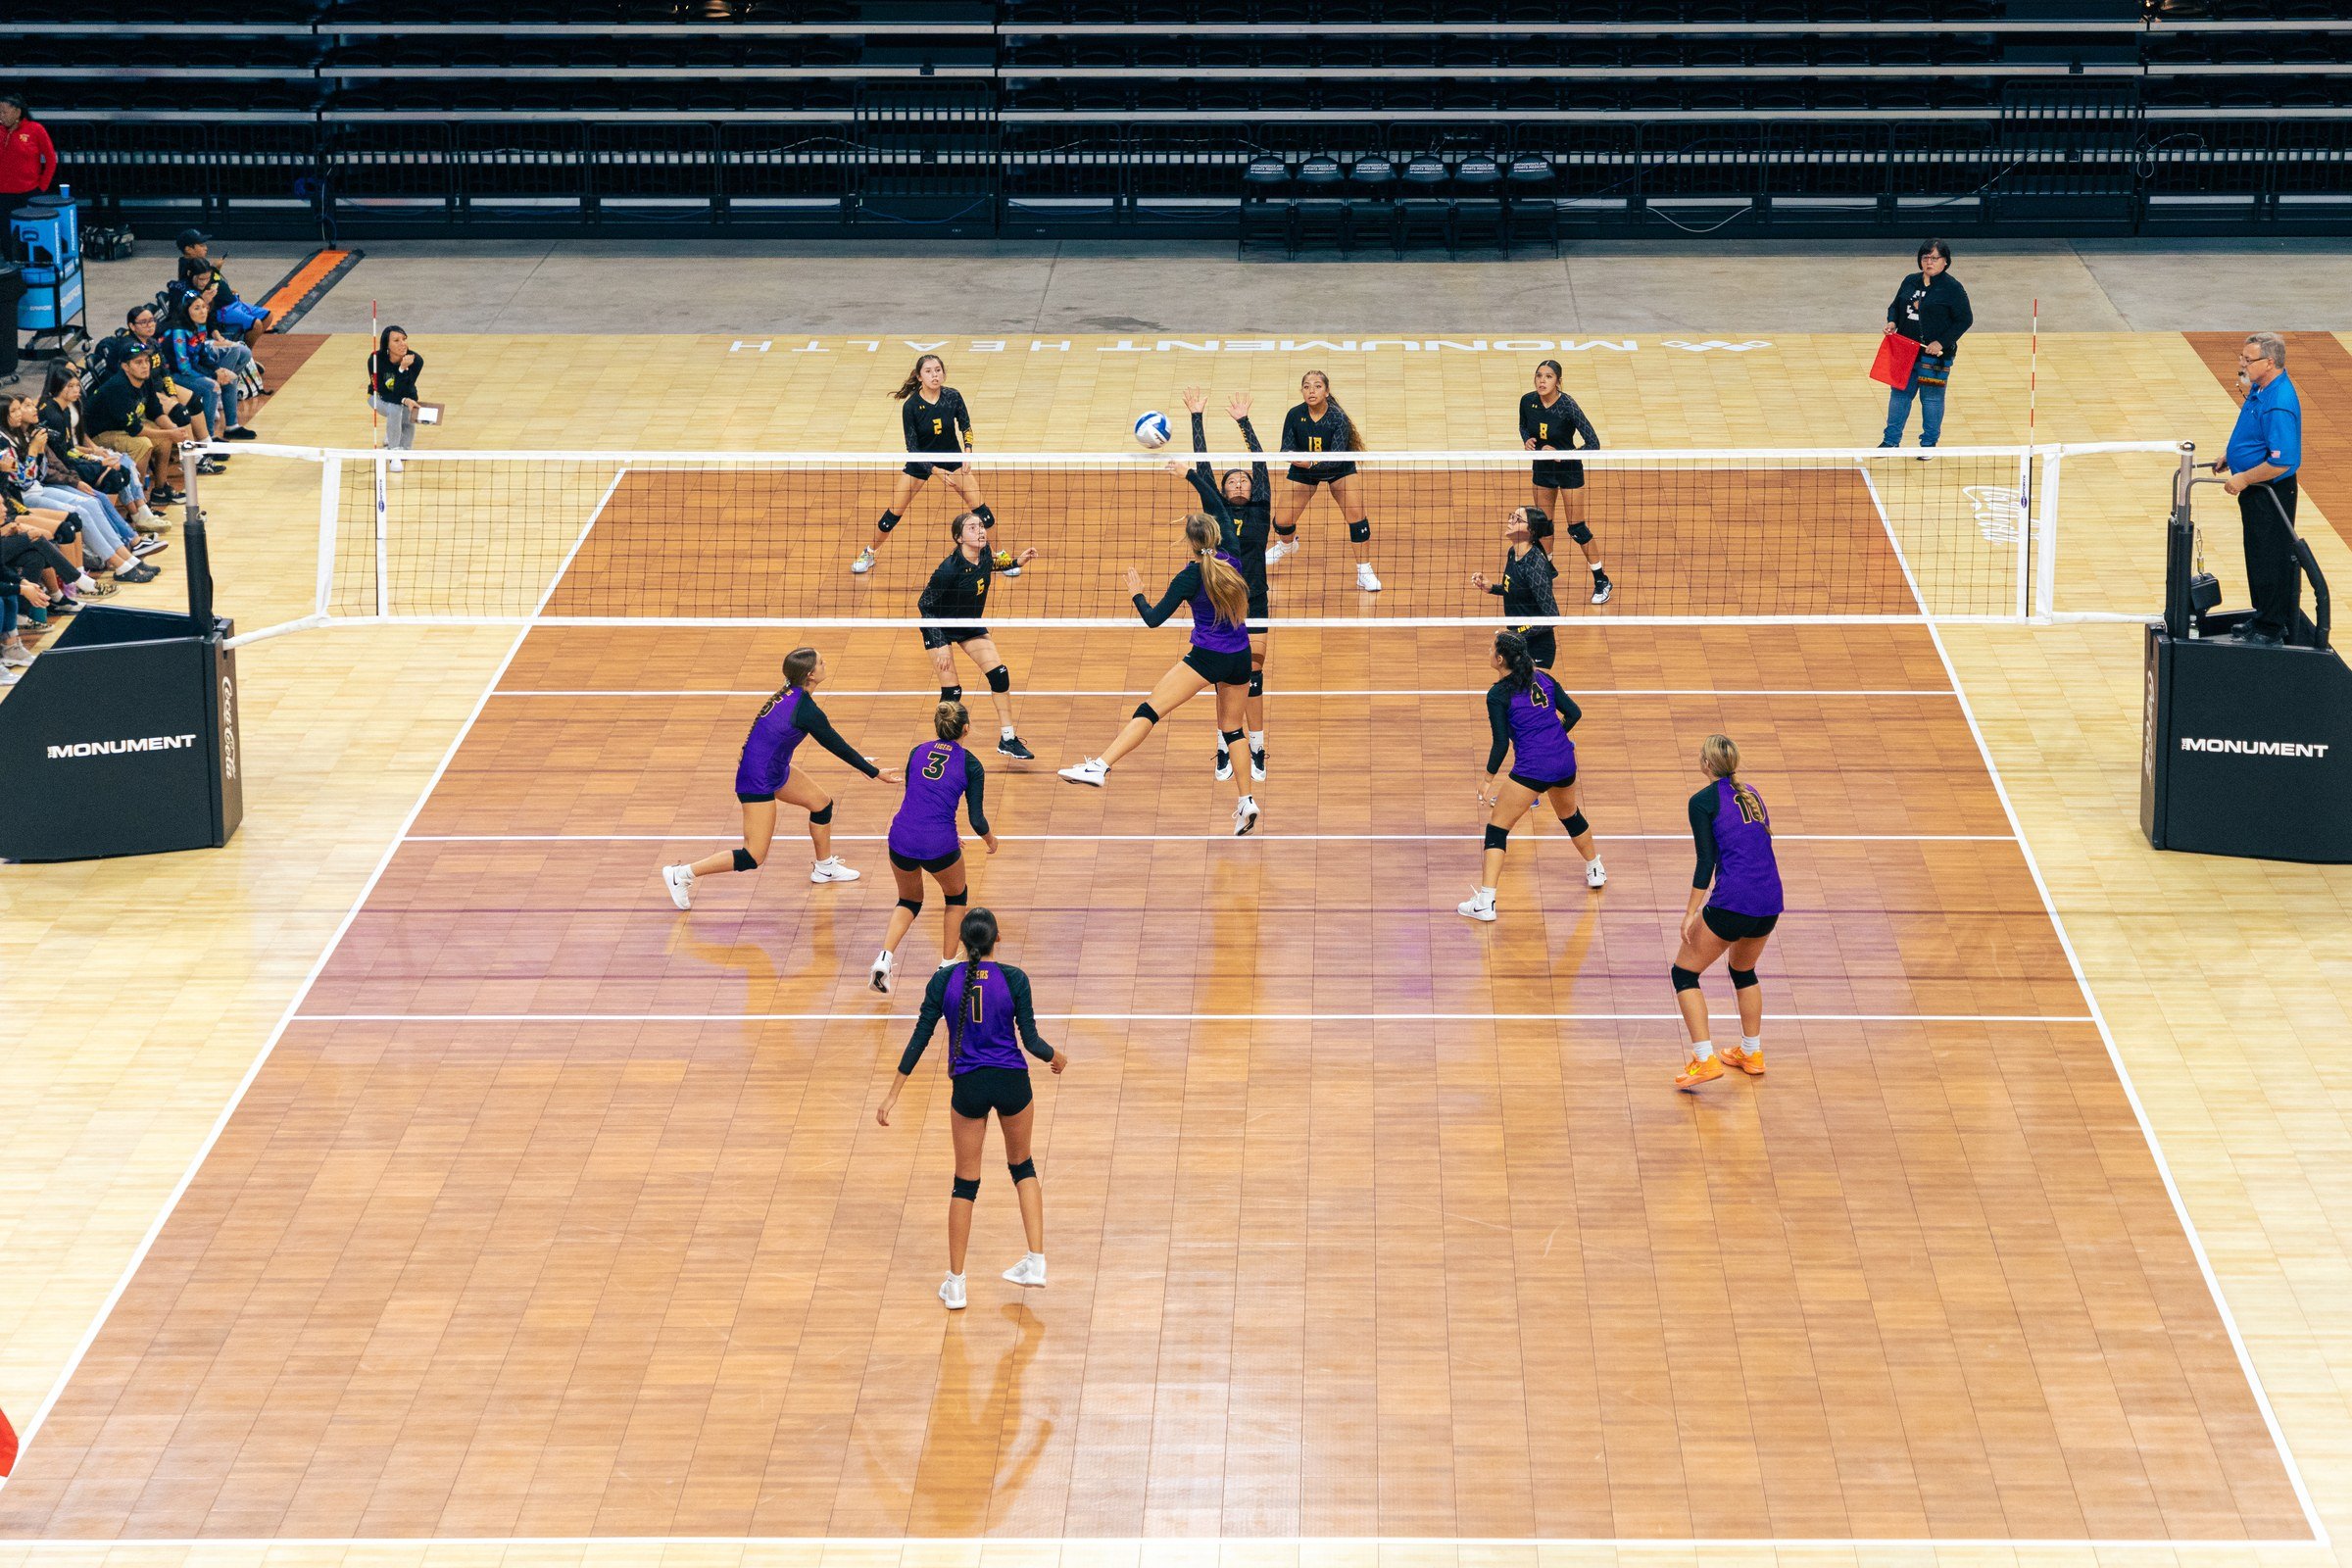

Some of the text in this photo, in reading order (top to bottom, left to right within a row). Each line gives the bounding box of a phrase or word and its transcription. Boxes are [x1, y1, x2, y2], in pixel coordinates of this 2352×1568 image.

[729, 340, 1639, 352] MONUMENT HEALTH
[932, 417, 943, 435] 2
[1539, 422, 1548, 440] 8
[1308, 436, 1322, 452] 18
[1233, 518, 1244, 536] 7
[1530, 682, 1549, 709] 4
[221, 676, 237, 780] Coca-Cola
[52, 734, 197, 759] MONUMENT
[2185, 738, 2328, 758] MONUMENT
[922, 751, 950, 780] 3
[971, 985, 983, 1023] 1
